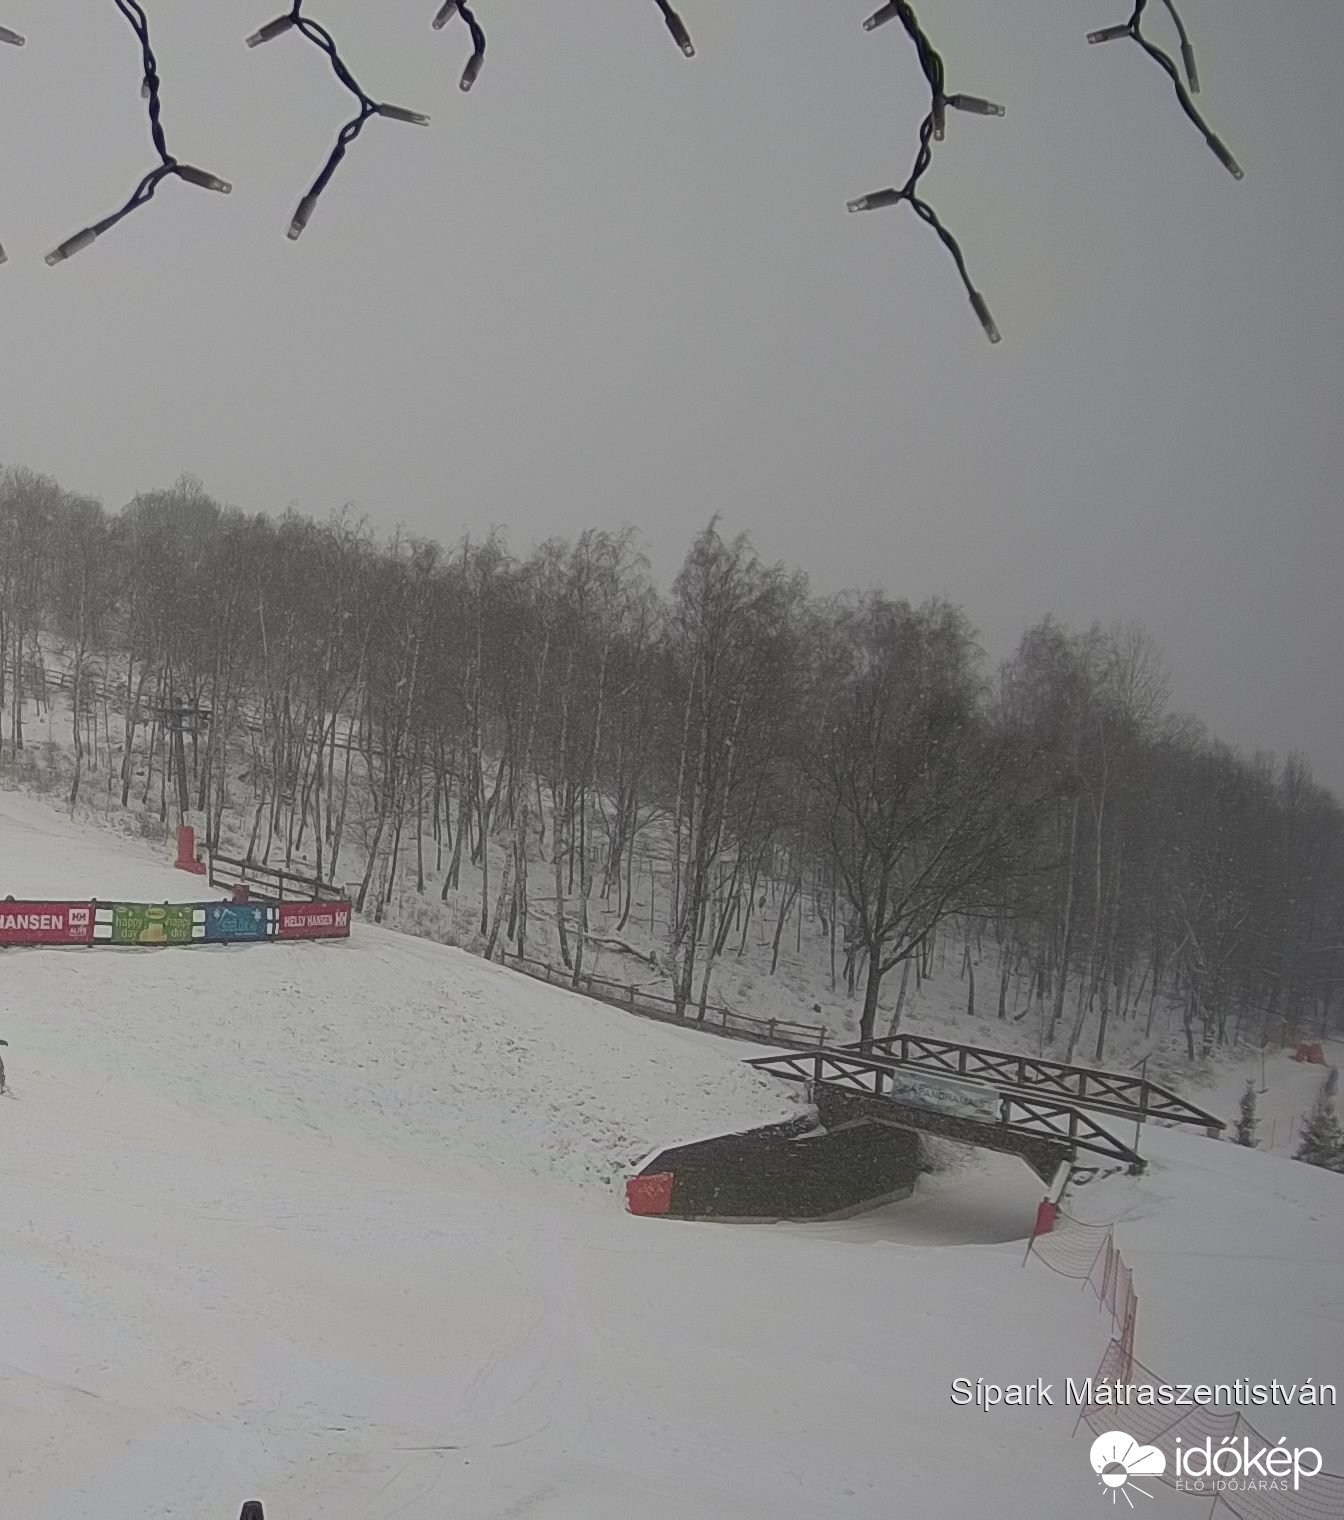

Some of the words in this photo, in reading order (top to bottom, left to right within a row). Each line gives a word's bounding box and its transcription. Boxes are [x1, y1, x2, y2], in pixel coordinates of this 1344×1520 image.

[116, 914, 143, 929] happy
[284, 915, 305, 927] HELLY
[307, 914, 333, 926] HANSEN
[121, 928, 138, 941] day
[171, 928, 187, 941] day
